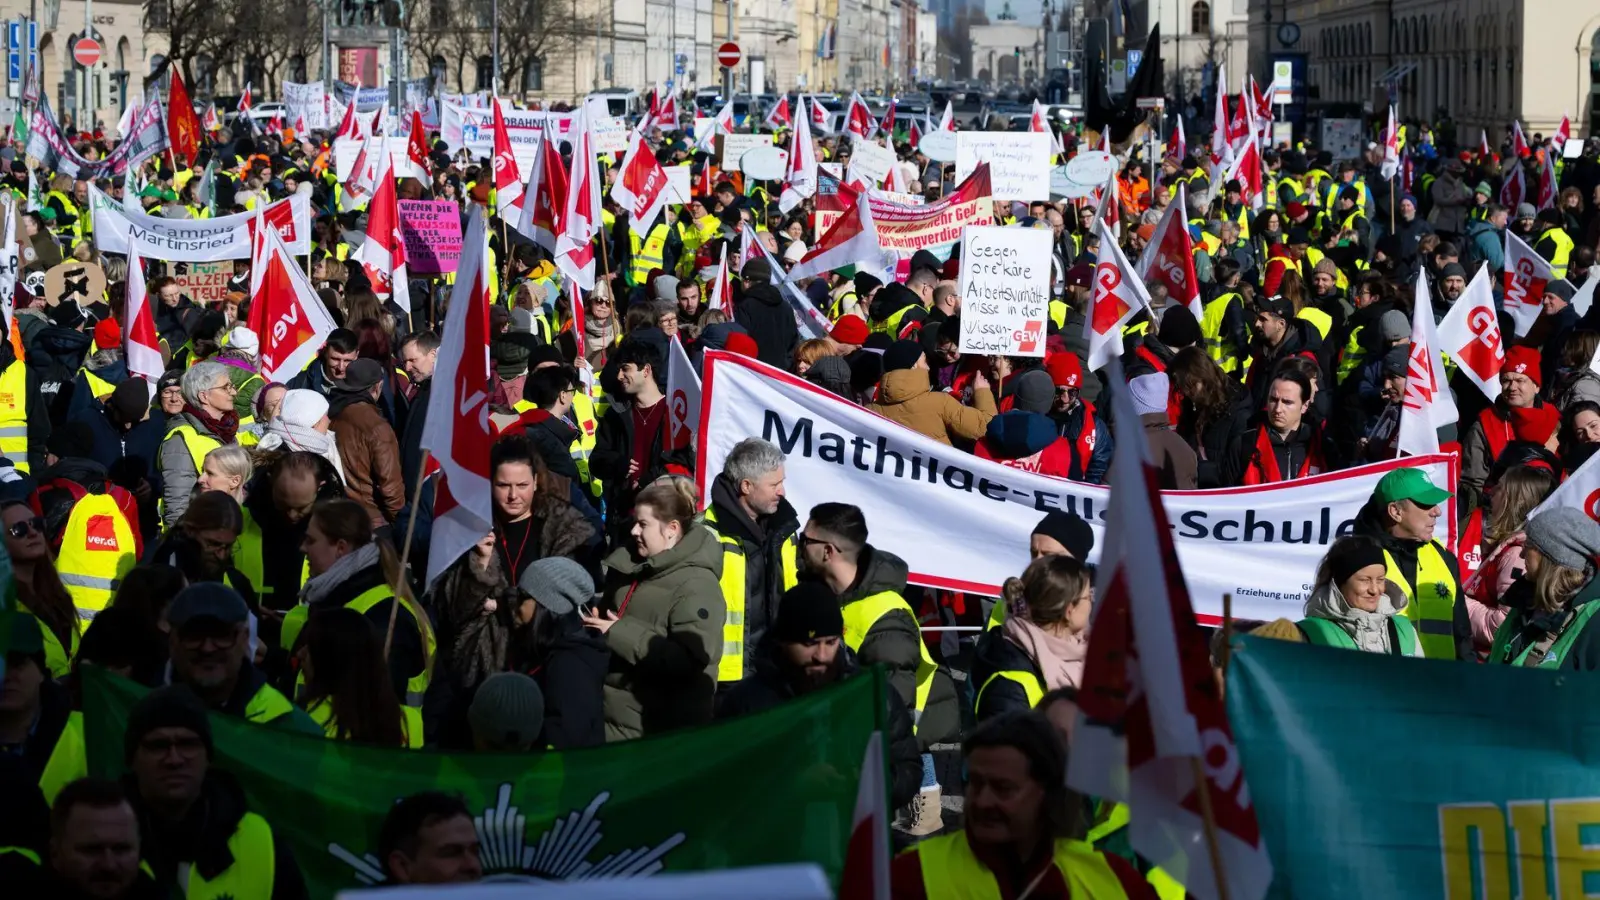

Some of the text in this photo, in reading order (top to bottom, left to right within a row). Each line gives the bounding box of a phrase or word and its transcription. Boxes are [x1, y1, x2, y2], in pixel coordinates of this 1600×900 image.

[400, 203, 452, 213] WENN DIE
[403, 212, 439, 220] PFLEGE
[956, 204, 977, 221] Geld
[128, 223, 234, 251] Martinsried
[152, 223, 235, 239] Campus
[971, 235, 1018, 266] Gegen
[971, 261, 1032, 281] prekäre
[966, 280, 1047, 303] Arbeitsverhält-
[968, 302, 1042, 318] nisse in der
[963, 319, 1012, 334] Wissen-
[966, 336, 1011, 352] schaft!
[1013, 330, 1043, 342] GEW
[87, 535, 117, 547] ver.di
[1236, 587, 1282, 600] Erziehung
[1283, 592, 1301, 600] und
